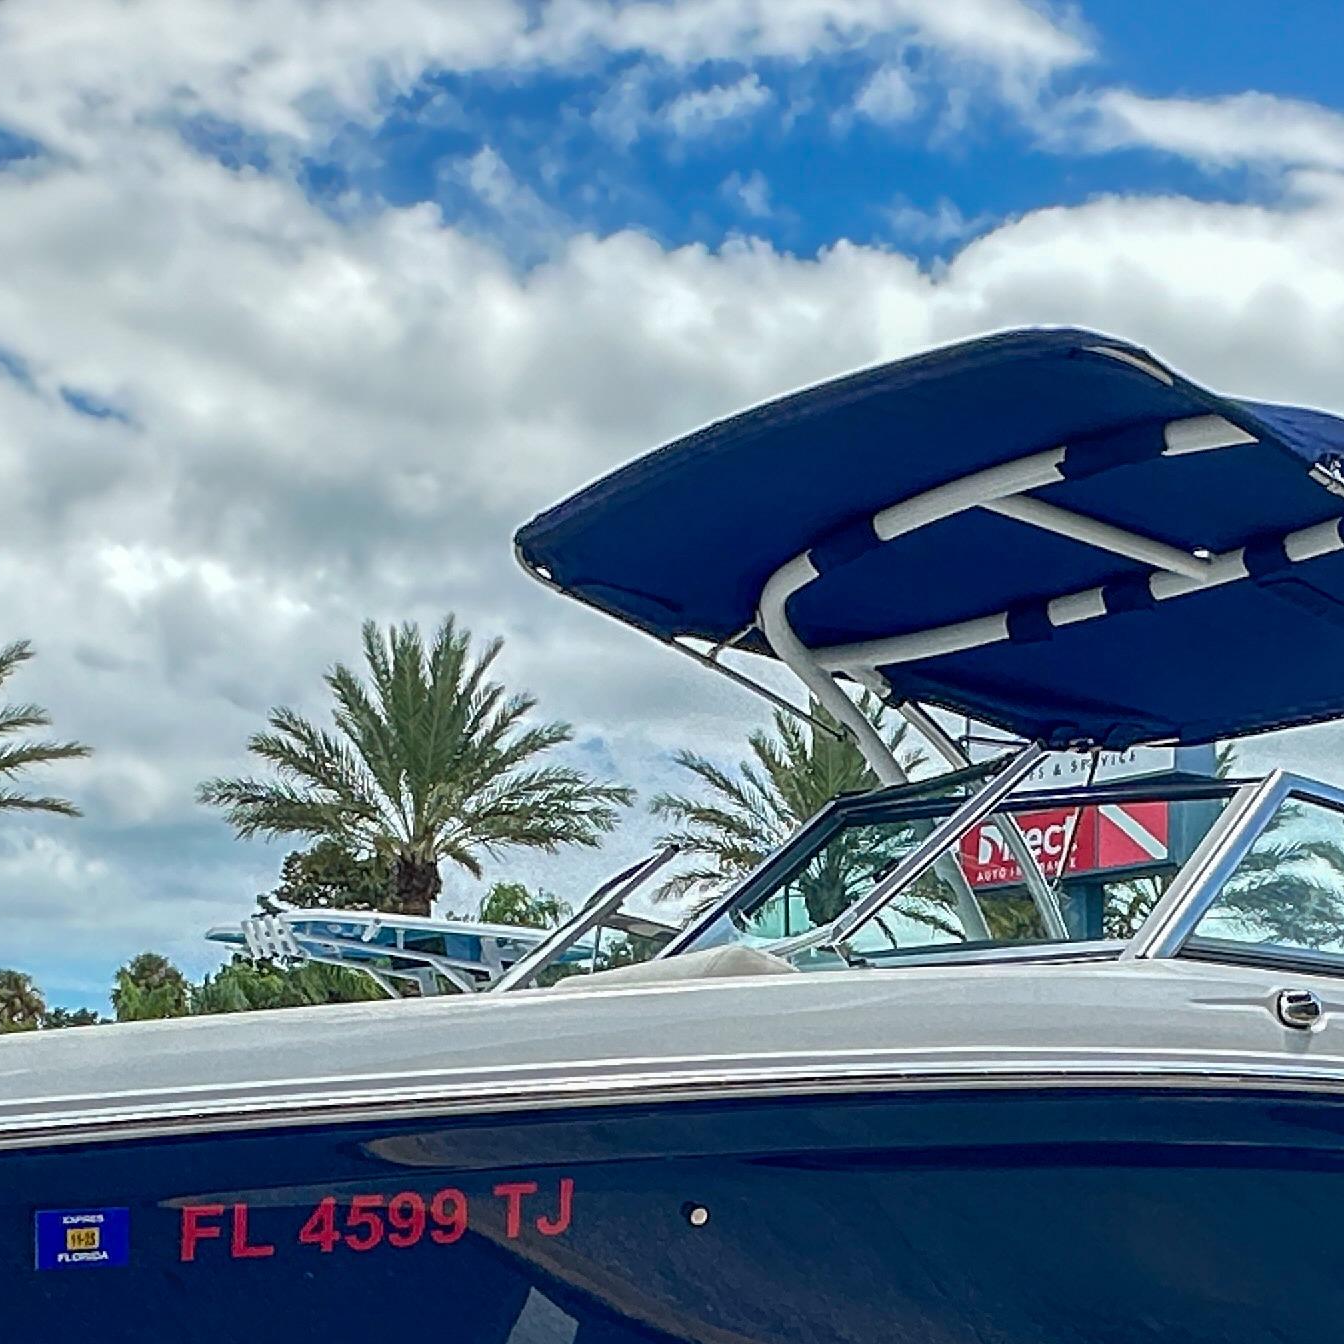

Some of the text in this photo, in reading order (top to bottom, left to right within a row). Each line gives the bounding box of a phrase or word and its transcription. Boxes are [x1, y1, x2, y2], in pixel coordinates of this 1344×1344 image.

[1070, 750, 1136, 774] SEVICE
[976, 866, 1008, 882] AUTO
[180, 1177, 575, 1263] FL 4599 TJ
[57, 1251, 110, 1263] FLORIDA
